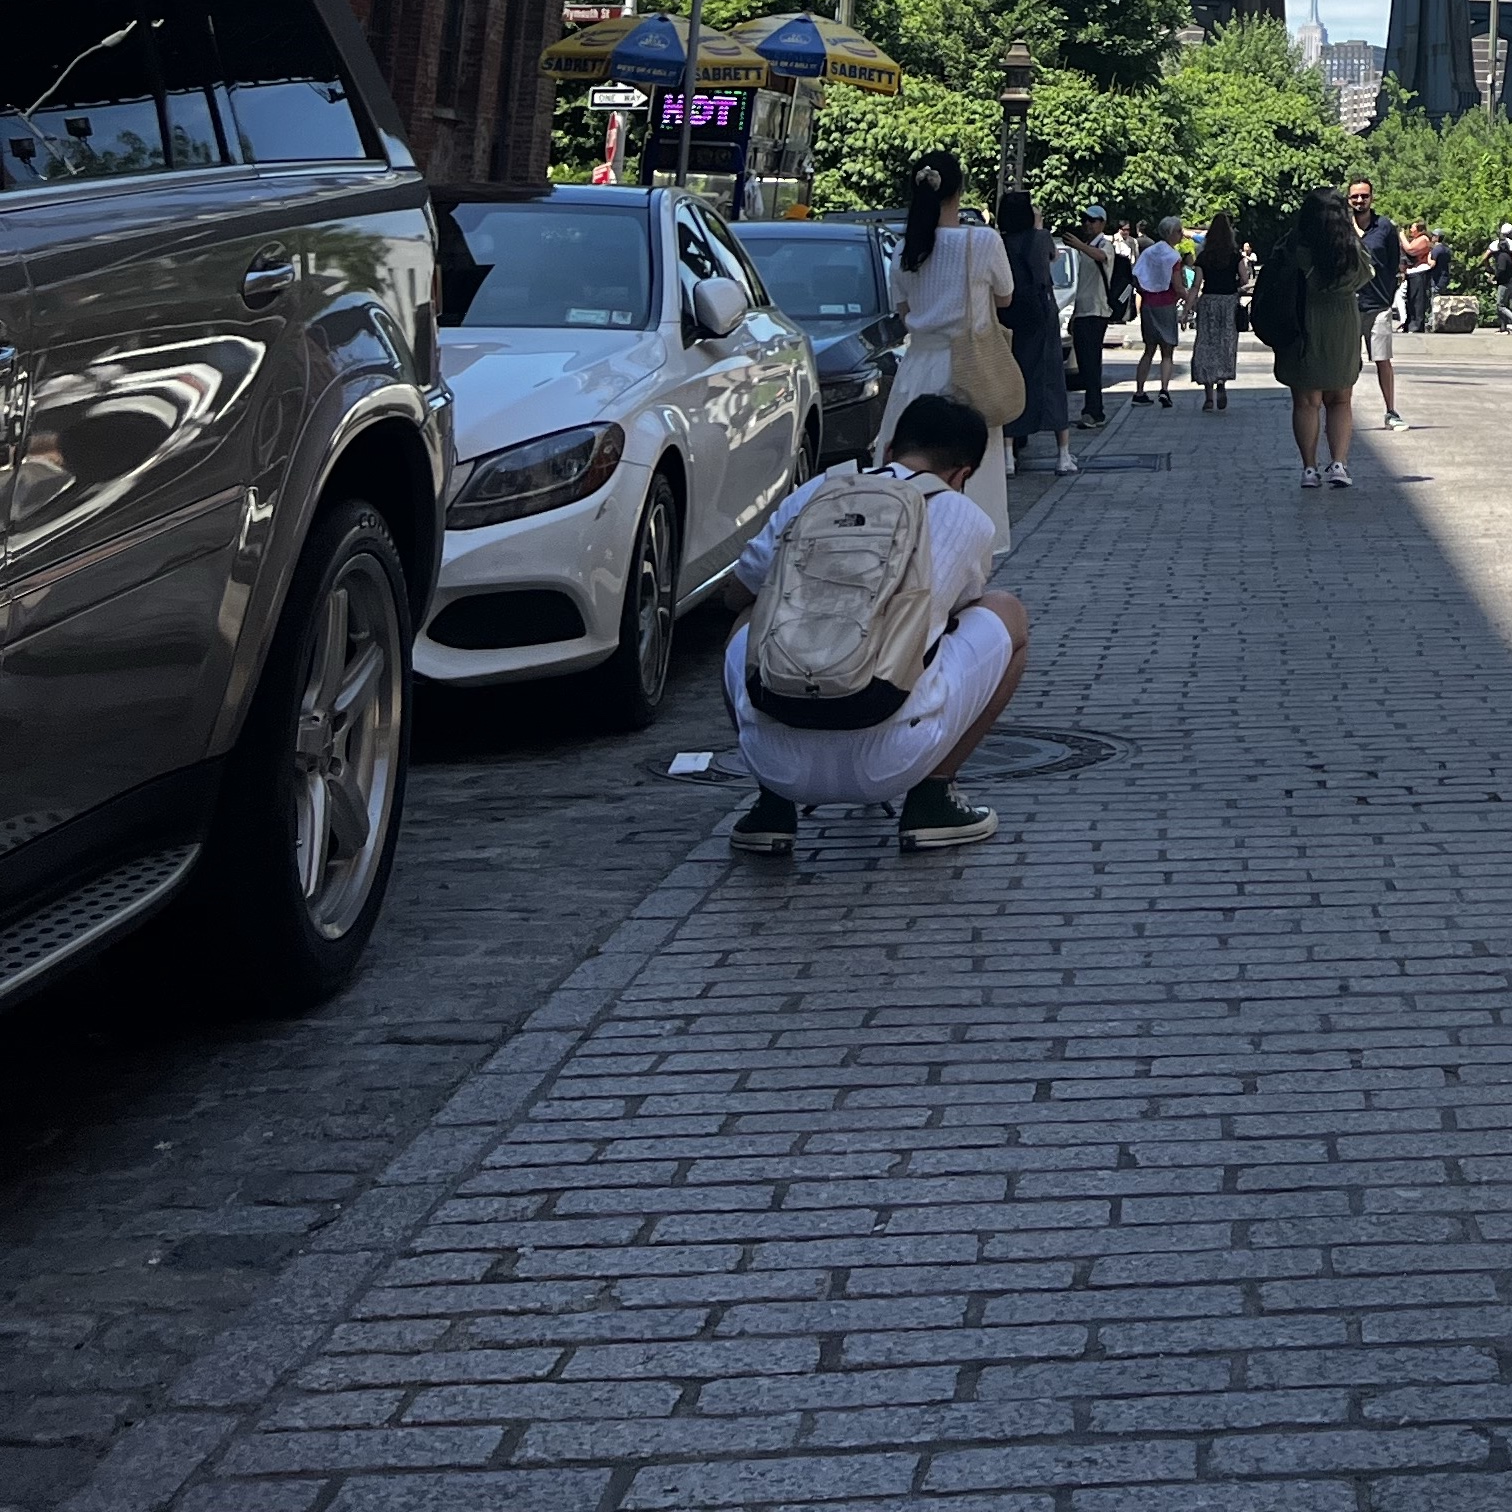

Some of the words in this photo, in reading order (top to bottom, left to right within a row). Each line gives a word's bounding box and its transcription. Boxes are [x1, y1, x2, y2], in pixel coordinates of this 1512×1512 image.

[830, 61, 895, 85] SABRETT
[598, 92, 616, 103] ONE
[624, 92, 641, 102] WAY
[661, 93, 738, 126] HOT
